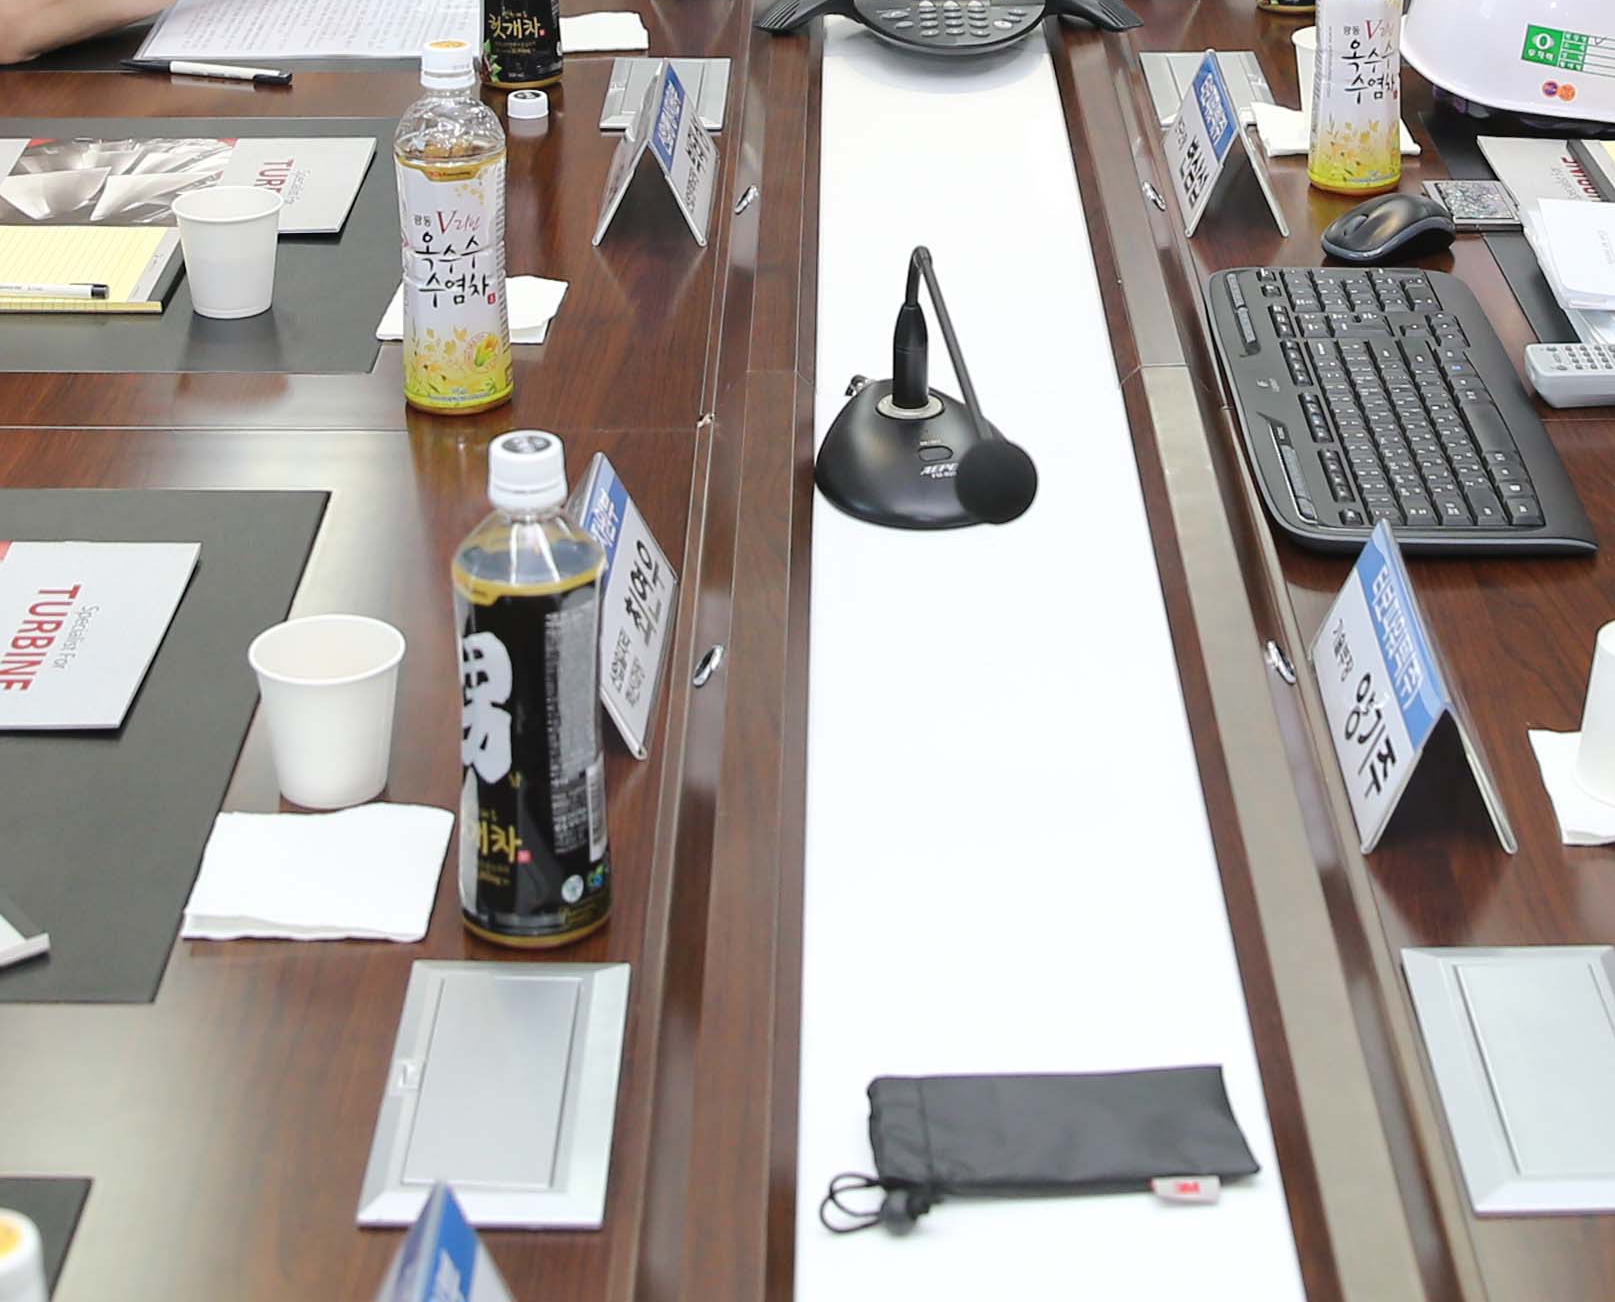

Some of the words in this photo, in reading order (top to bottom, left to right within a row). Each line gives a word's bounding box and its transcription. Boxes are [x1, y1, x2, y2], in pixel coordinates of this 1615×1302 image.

[488, 13, 541, 39] 헛개차
[1341, 39, 1396, 74] 옥수수
[1344, 73, 1395, 105] 수염차
[414, 231, 485, 274] 옥수수
[418, 273, 490, 309] 수염차
[624, 539, 665, 647] 최연우
[1345, 672, 1397, 798] 양기주
